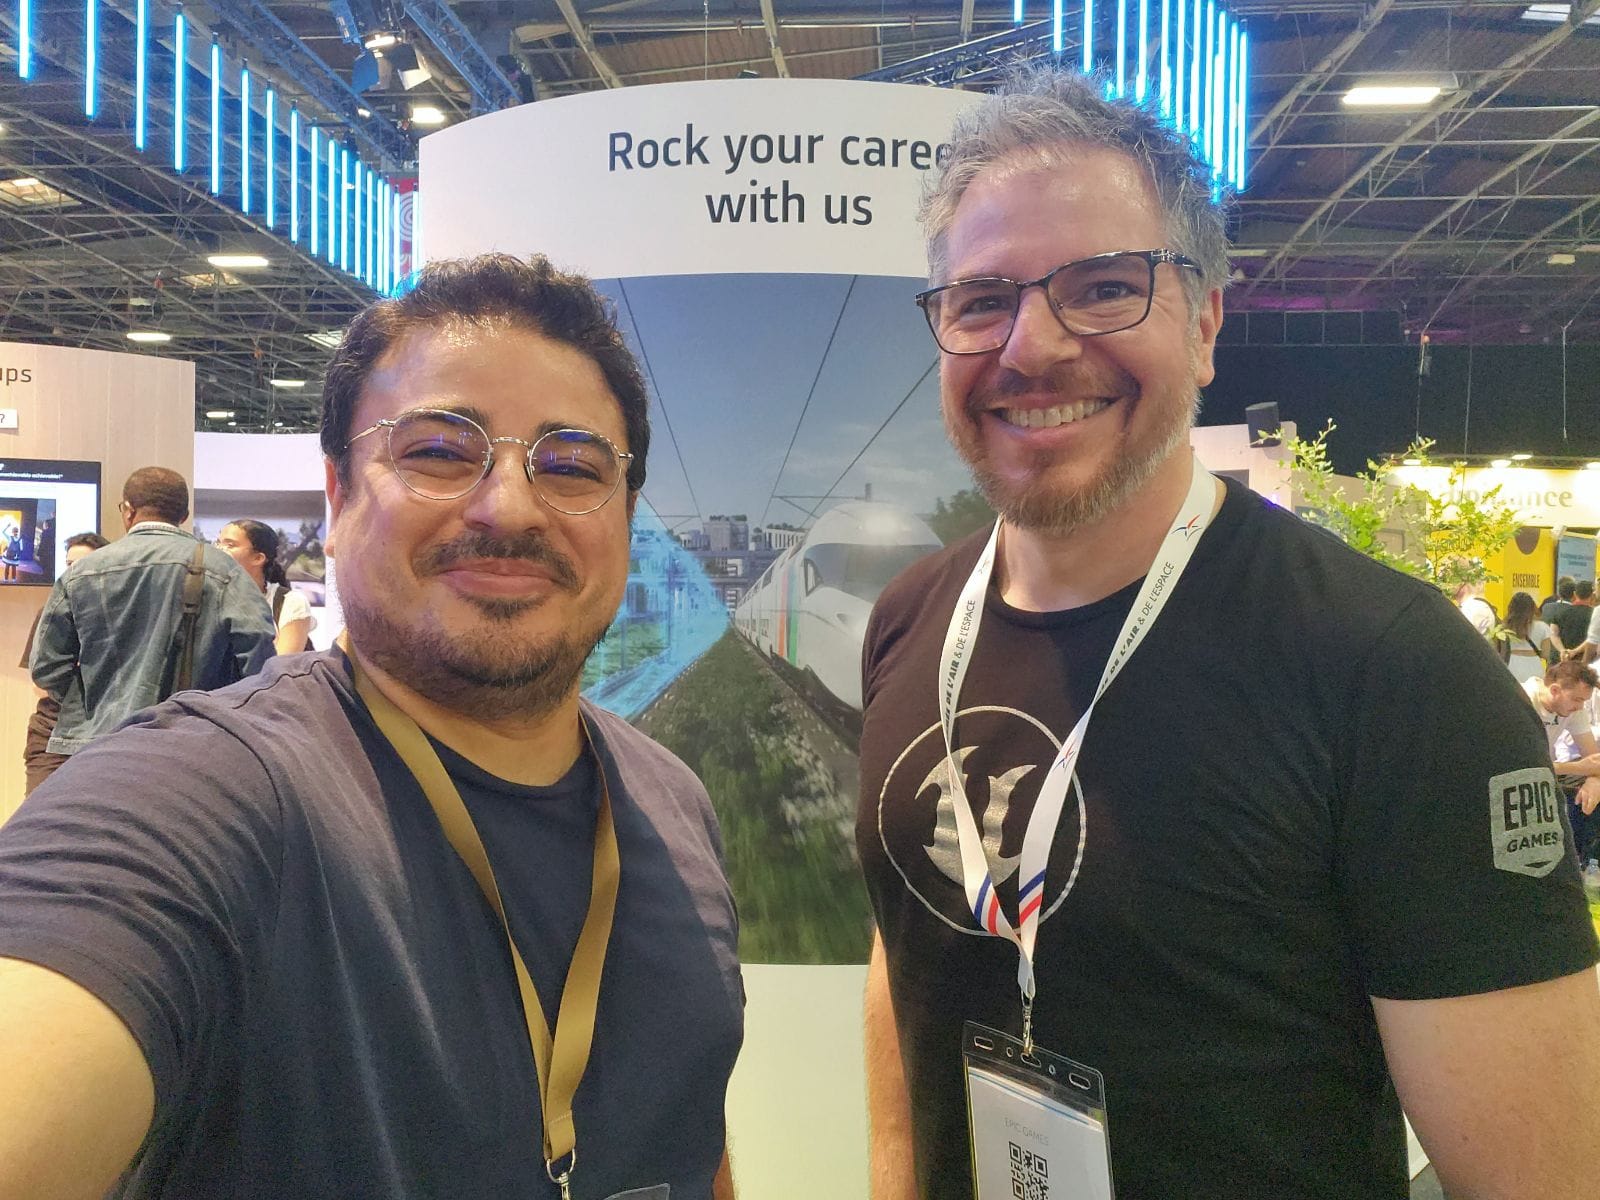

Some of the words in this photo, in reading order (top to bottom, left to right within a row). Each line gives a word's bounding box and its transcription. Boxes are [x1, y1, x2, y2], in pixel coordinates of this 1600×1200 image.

[609, 123, 711, 171] Rock
[723, 132, 824, 175] your
[840, 134, 952, 170] caree
[705, 180, 805, 223] with
[824, 194, 873, 226] us
[0, 367, 32, 386] ps
[1512, 573, 1540, 589] ENSEMBLE
[959, 599, 976, 637] L'ESPACE
[1120, 625, 1140, 656] L'AIR
[1137, 616, 1146, 626] &
[1142, 602, 1153, 616] DE
[1149, 561, 1175, 602] L'ESPACE
[955, 637, 965, 650] DE
[956, 651, 963, 659] &
[946, 660, 960, 689] L'AIR
[1503, 781, 1555, 831] EPIC
[1507, 832, 1559, 853] GAMES
[1004, 1117, 1021, 1133] EPIC
[1022, 1126, 1049, 1146] GAMES
